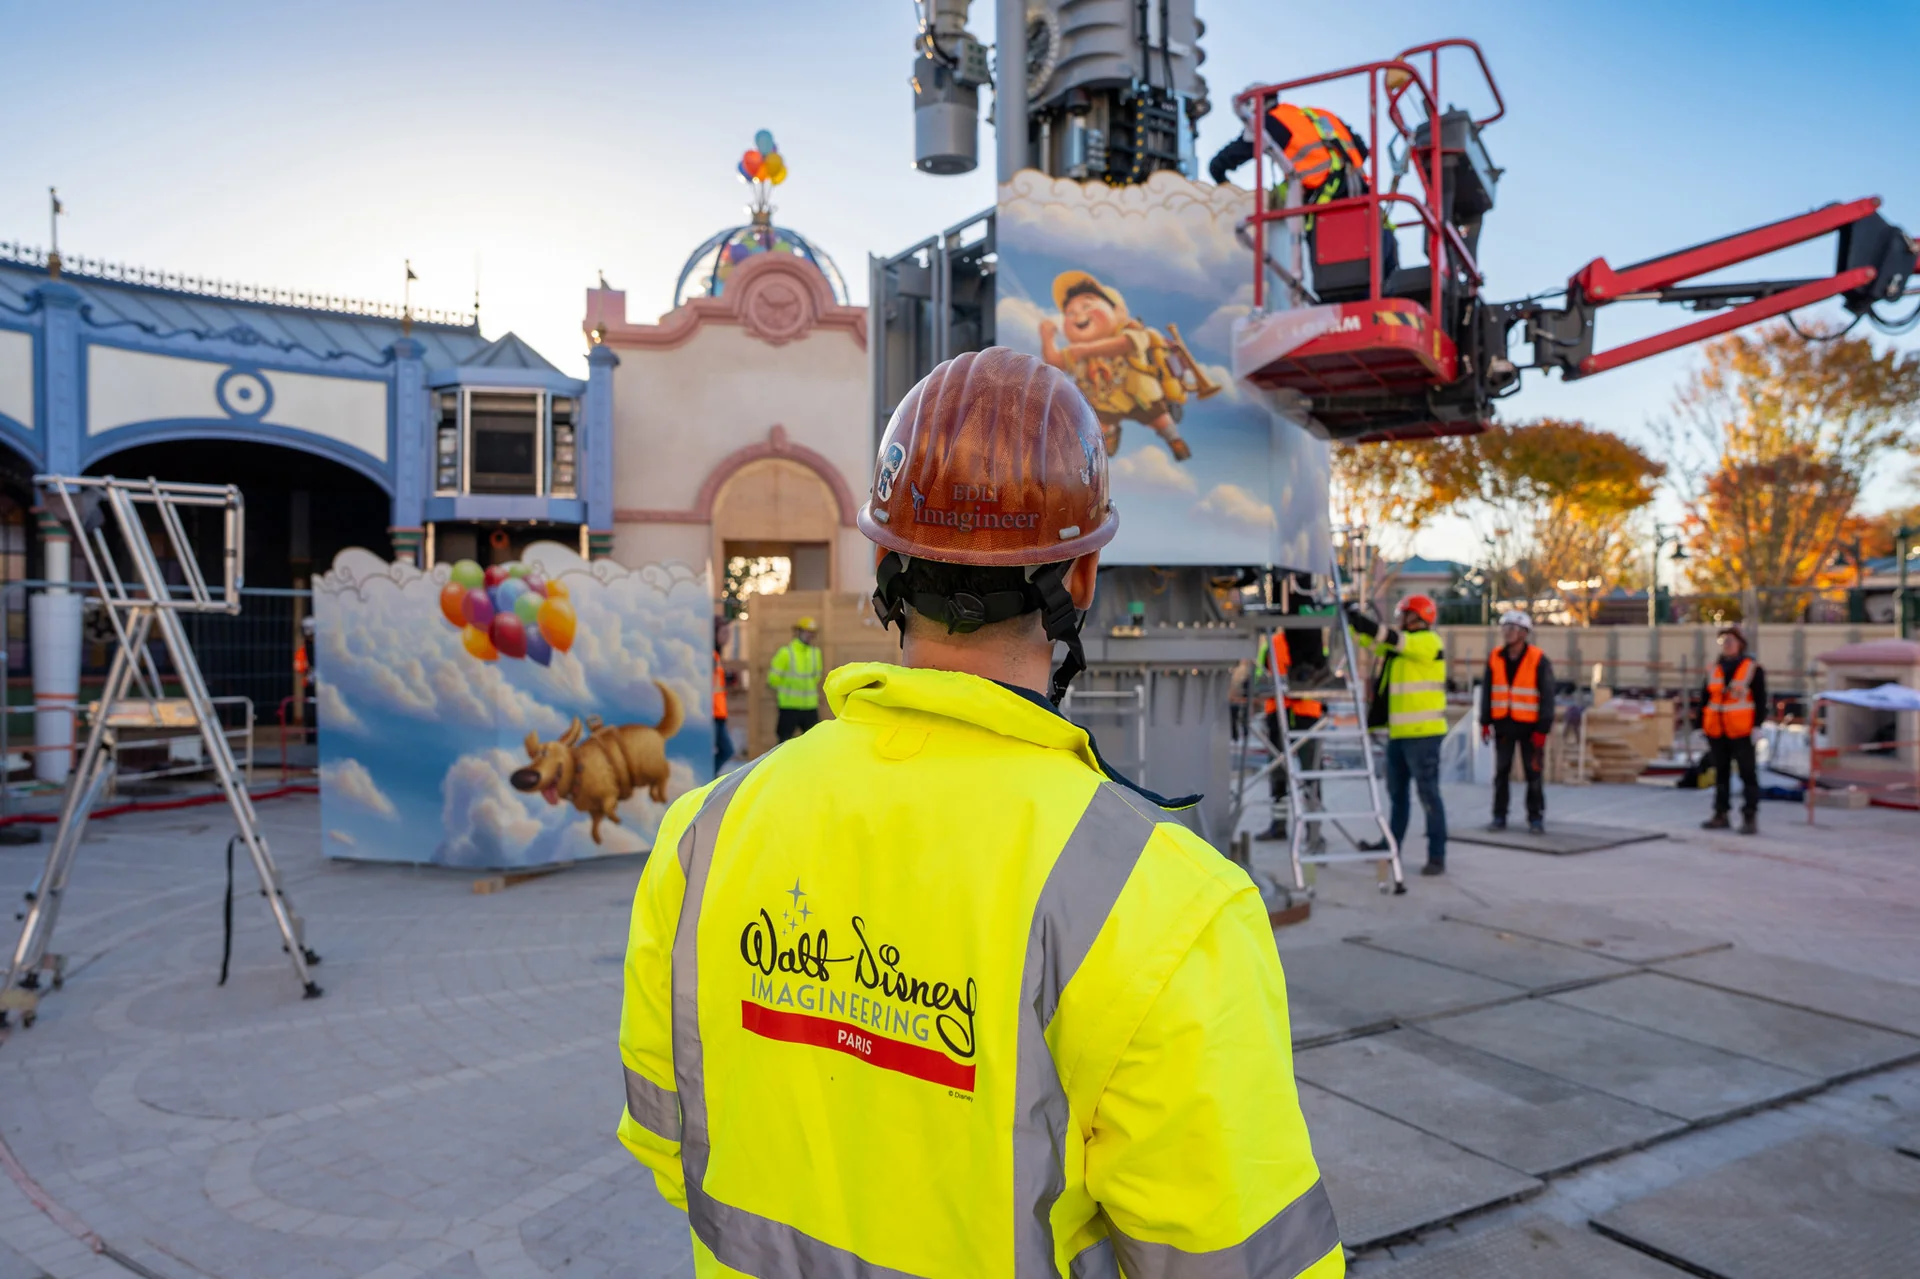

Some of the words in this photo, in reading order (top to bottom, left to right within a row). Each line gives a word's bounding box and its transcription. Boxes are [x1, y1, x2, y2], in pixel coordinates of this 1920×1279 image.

[914, 503, 1039, 532] Imagineer
[740, 908, 854, 982] Walt
[851, 916, 977, 1058] Disney
[751, 972, 930, 1042] IMAGINEERING
[837, 1029, 872, 1055] PARIS
[954, 1091, 974, 1103] Disney
